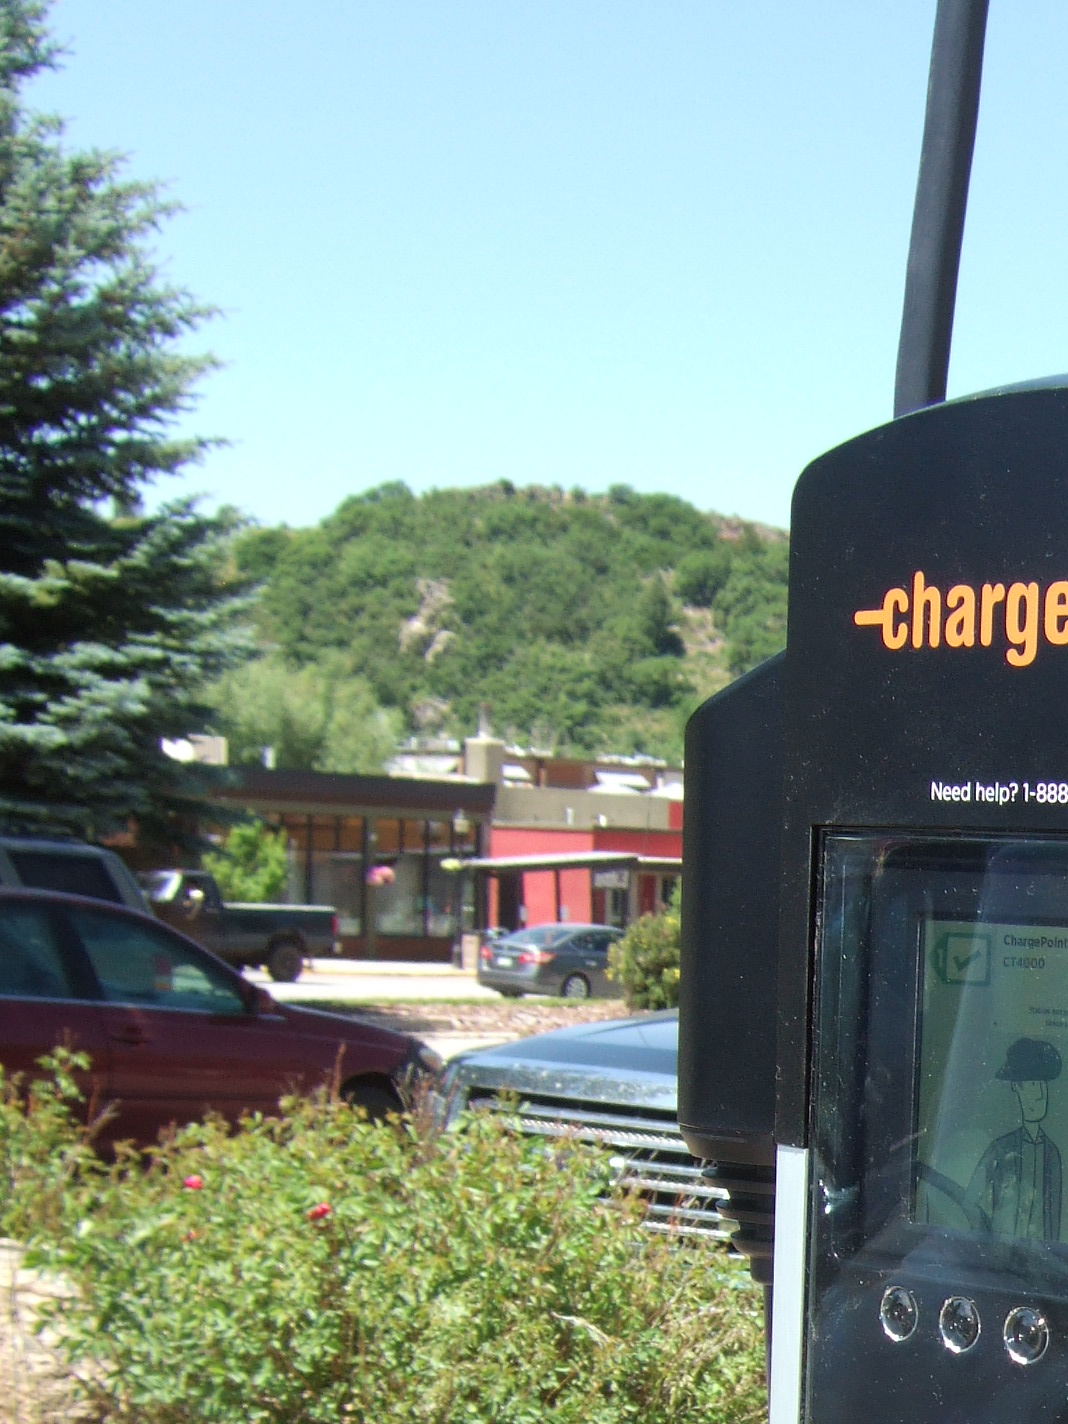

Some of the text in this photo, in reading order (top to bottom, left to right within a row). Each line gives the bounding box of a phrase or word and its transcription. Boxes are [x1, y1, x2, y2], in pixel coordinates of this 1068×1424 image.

[931, 781, 971, 802] Need
[975, 781, 1019, 806] help?
[1004, 934, 1068, 950] ChargePoint
